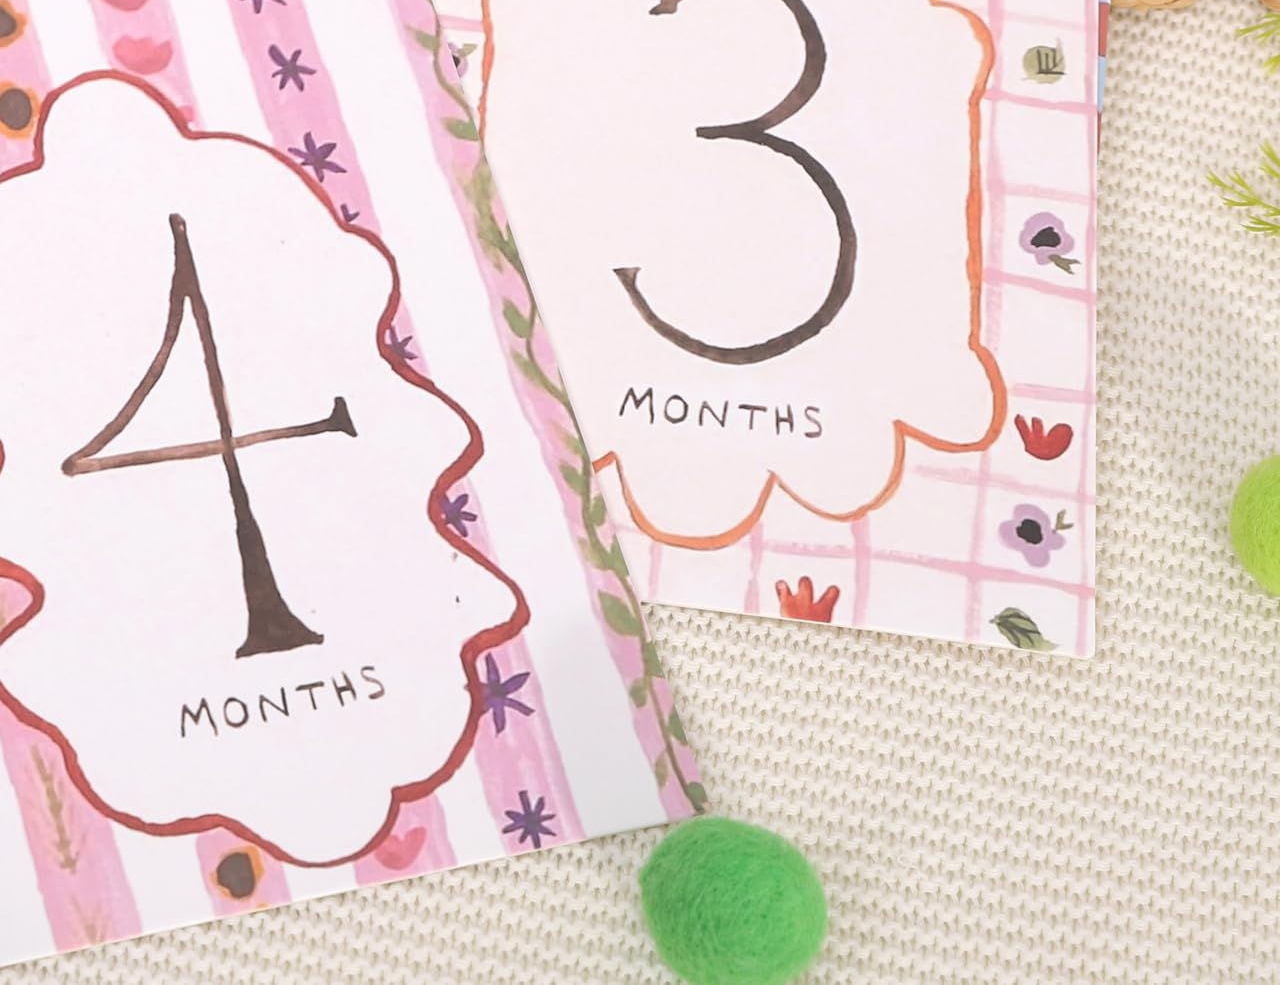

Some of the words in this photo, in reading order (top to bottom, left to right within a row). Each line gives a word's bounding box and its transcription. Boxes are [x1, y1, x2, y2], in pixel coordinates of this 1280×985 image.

[60, 212, 359, 661] 4
[617, 385, 825, 440] MONTHS
[178, 664, 386, 739] MONTHS
